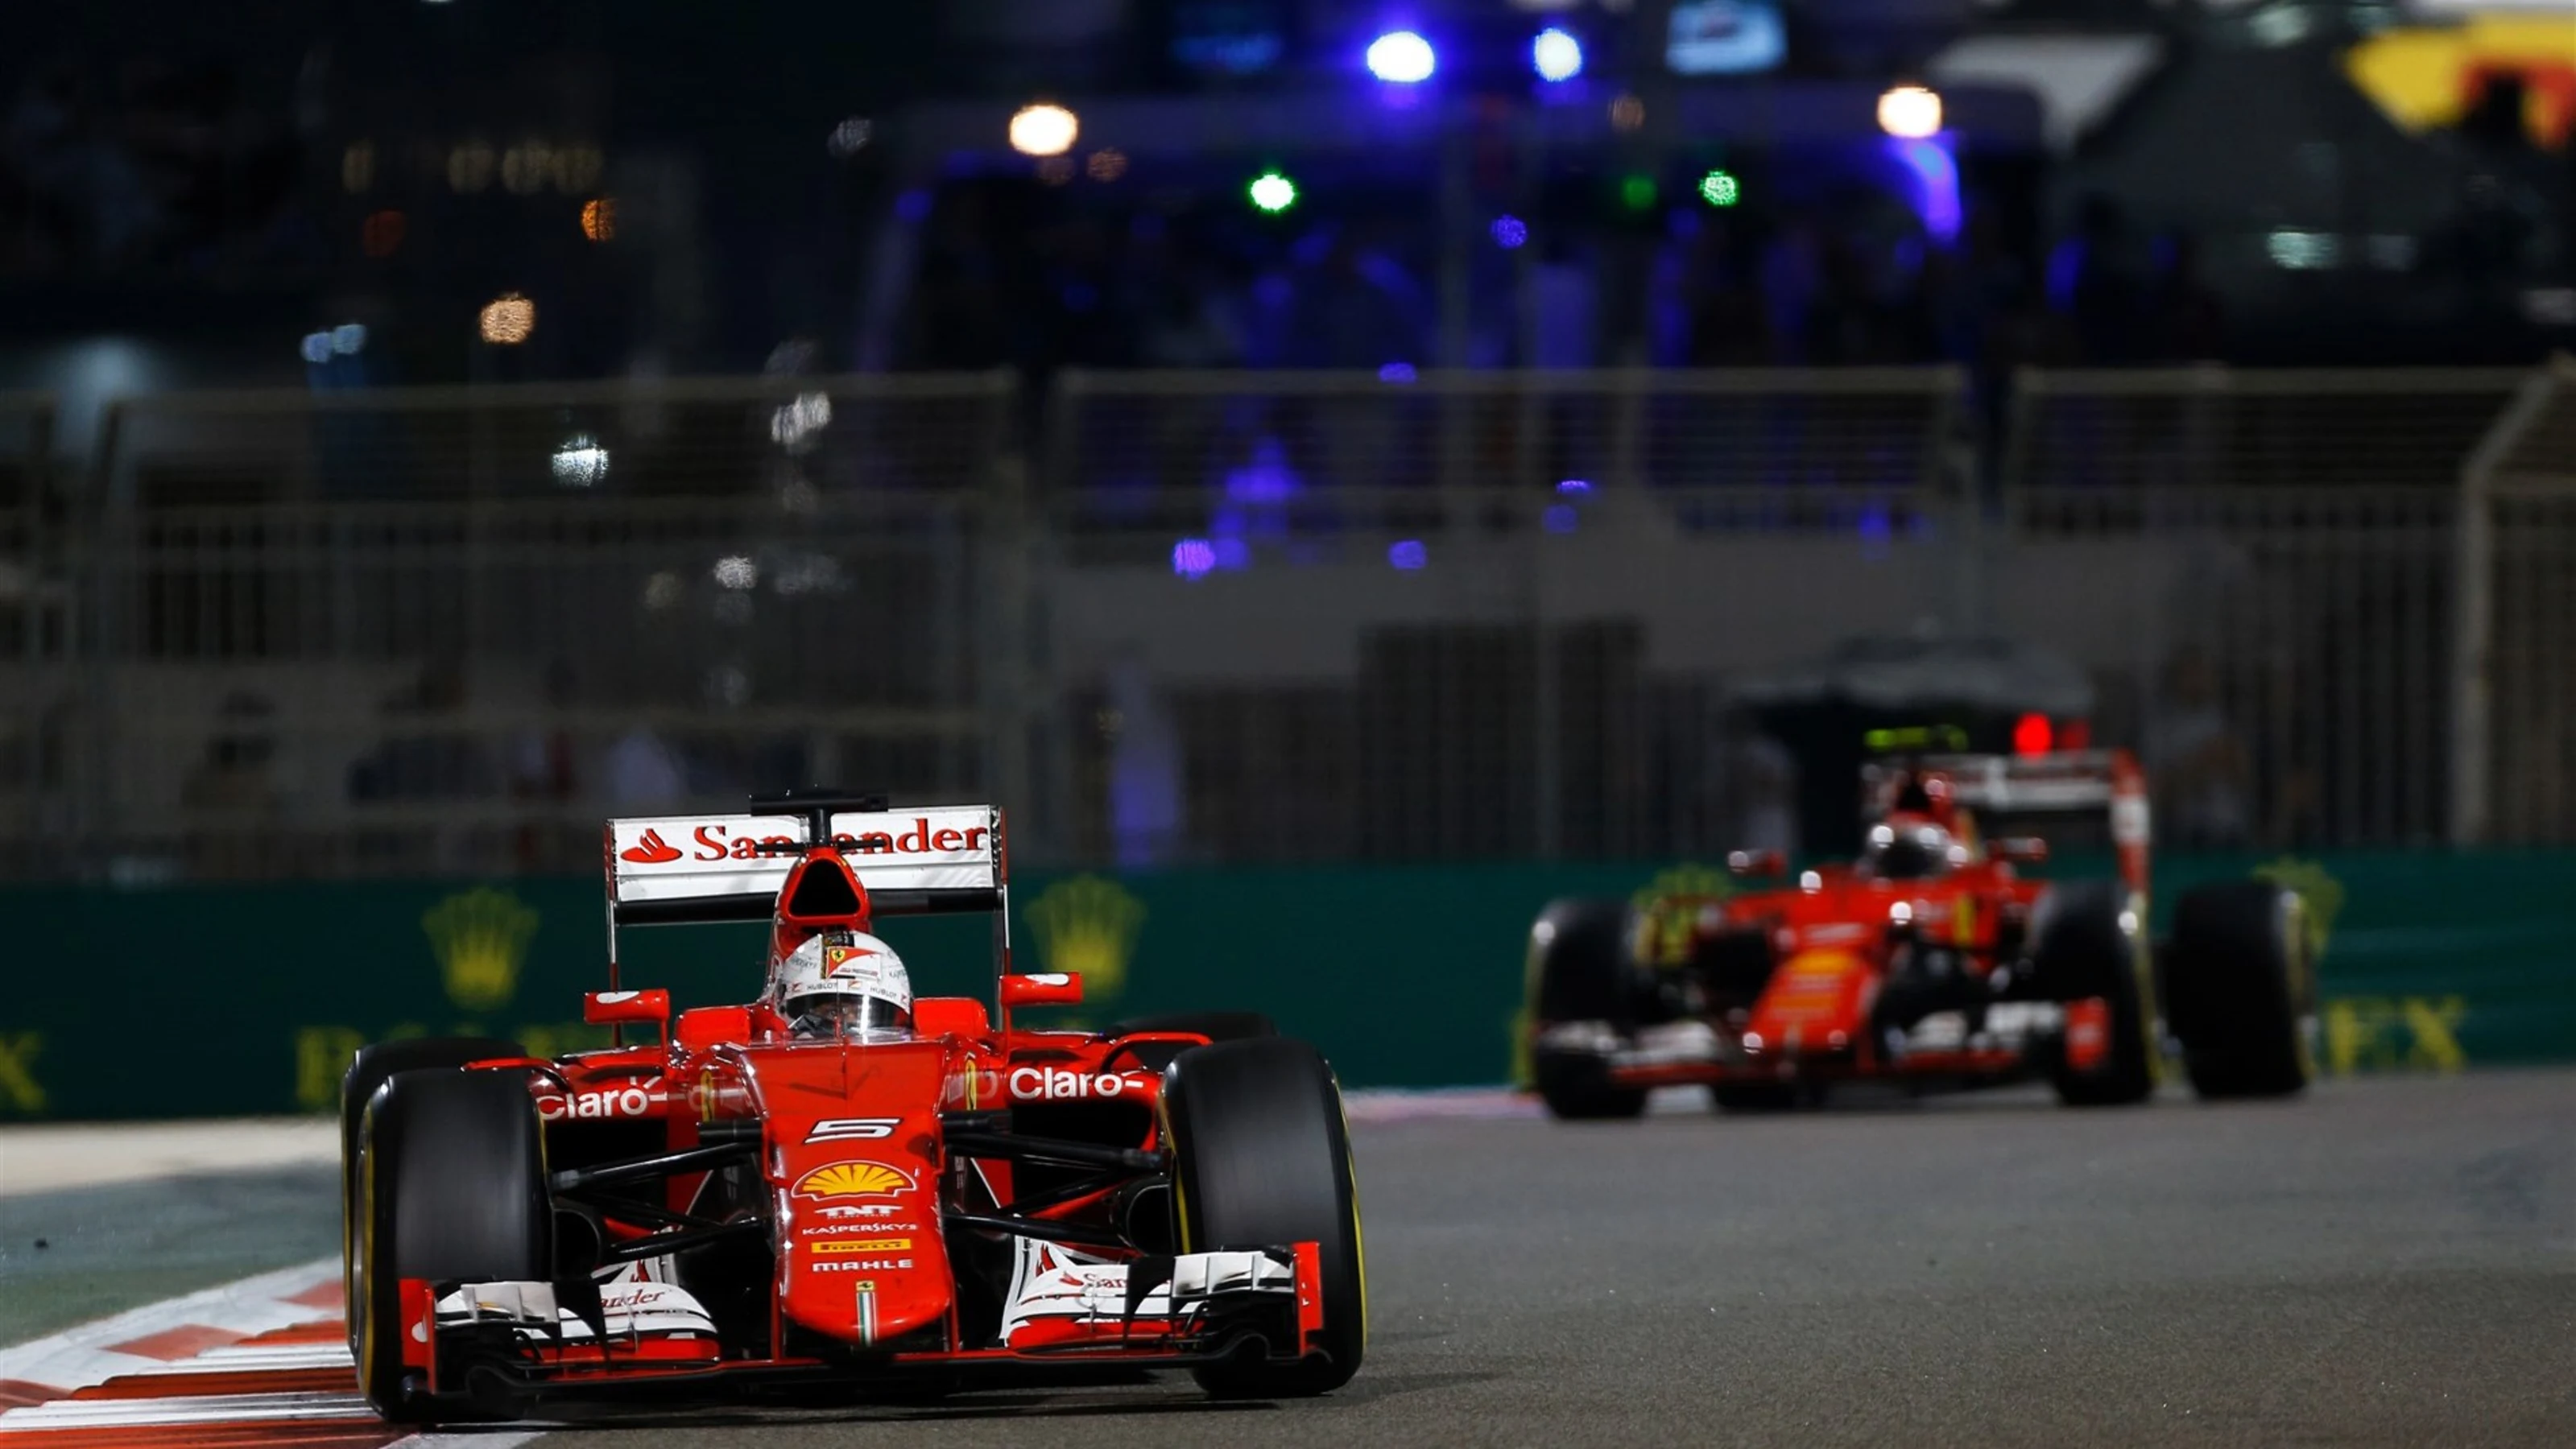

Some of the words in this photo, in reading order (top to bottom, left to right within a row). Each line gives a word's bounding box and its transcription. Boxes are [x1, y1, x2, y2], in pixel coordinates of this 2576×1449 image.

[693, 817, 988, 861] Sanander
[1010, 1067, 1123, 1100] Claro
[536, 1088, 648, 1121] Claro
[804, 1118, 902, 1144] 5
[814, 1204, 903, 1216] TNT
[802, 1223, 908, 1235] KASPERSKY
[812, 1259, 912, 1272] MAHLE
